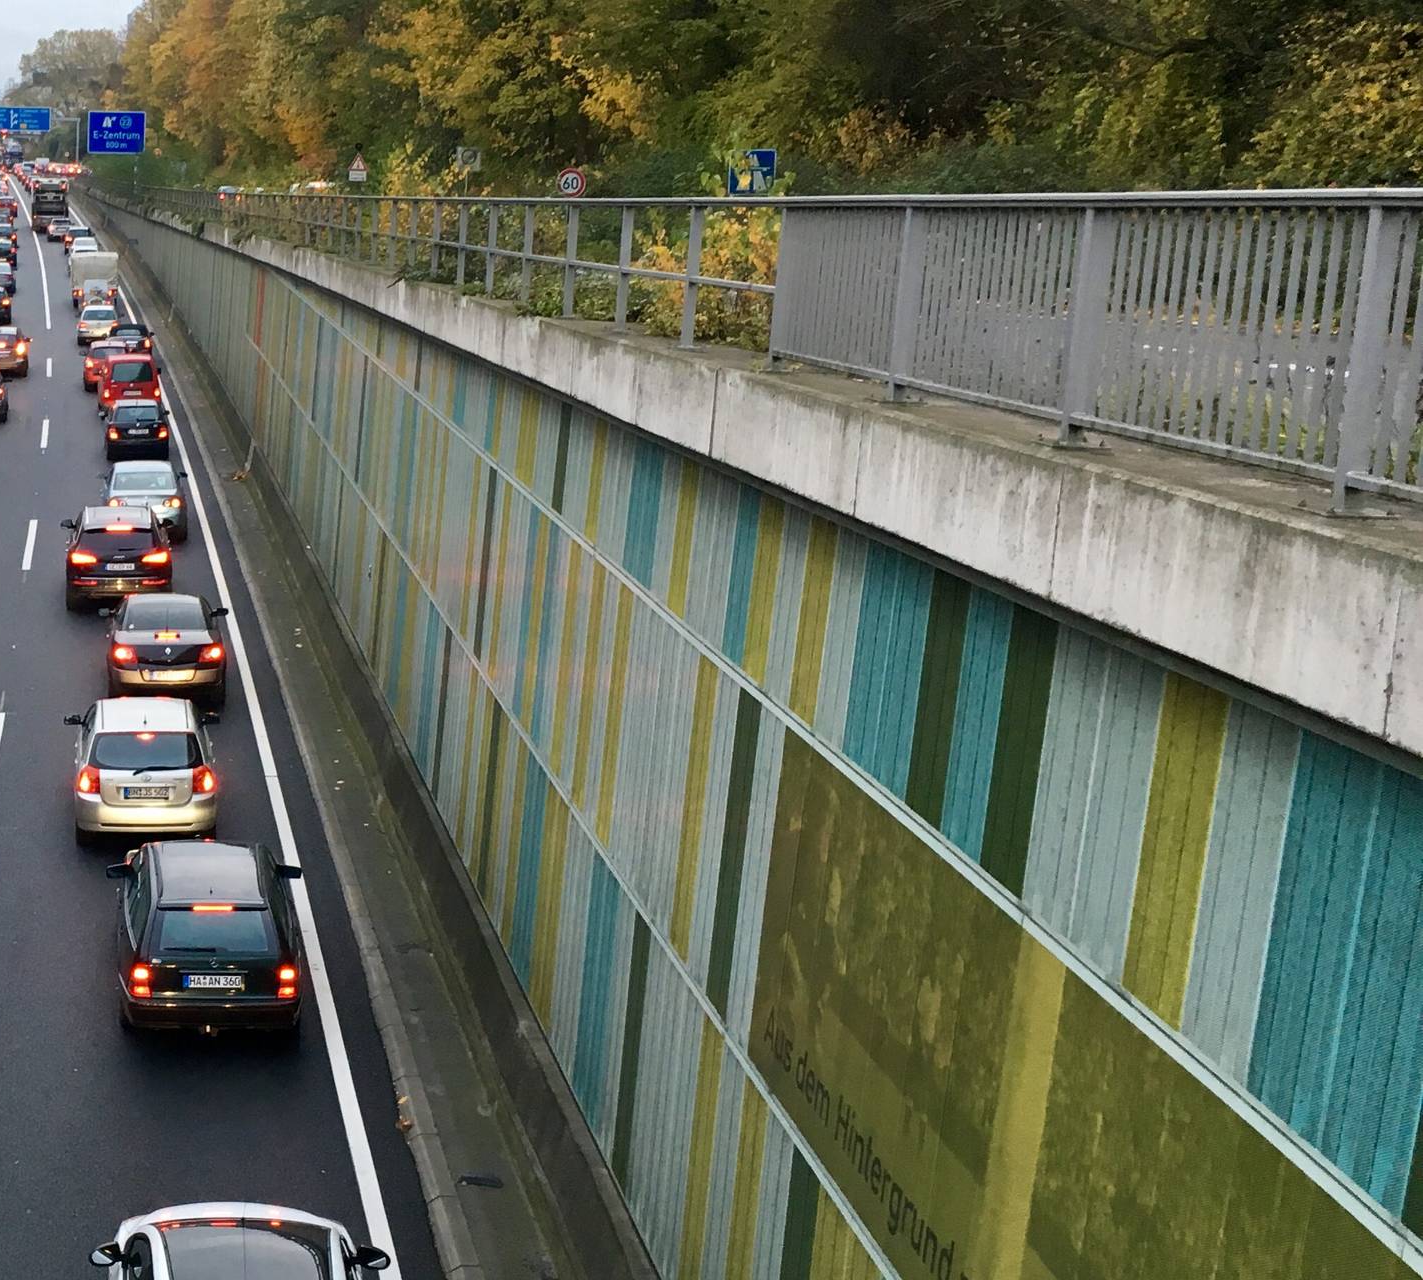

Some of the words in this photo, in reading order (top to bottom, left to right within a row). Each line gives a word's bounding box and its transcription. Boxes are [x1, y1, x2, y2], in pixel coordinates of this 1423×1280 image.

[93, 130, 140, 140] E-Zentrum
[563, 177, 578, 190] 60
[189, 976, 202, 986] HA
[209, 976, 221, 986] AN
[763, 1005, 792, 1072] Aus
[795, 1052, 831, 1128] dem
[834, 1095, 955, 1280] Hintergrund
